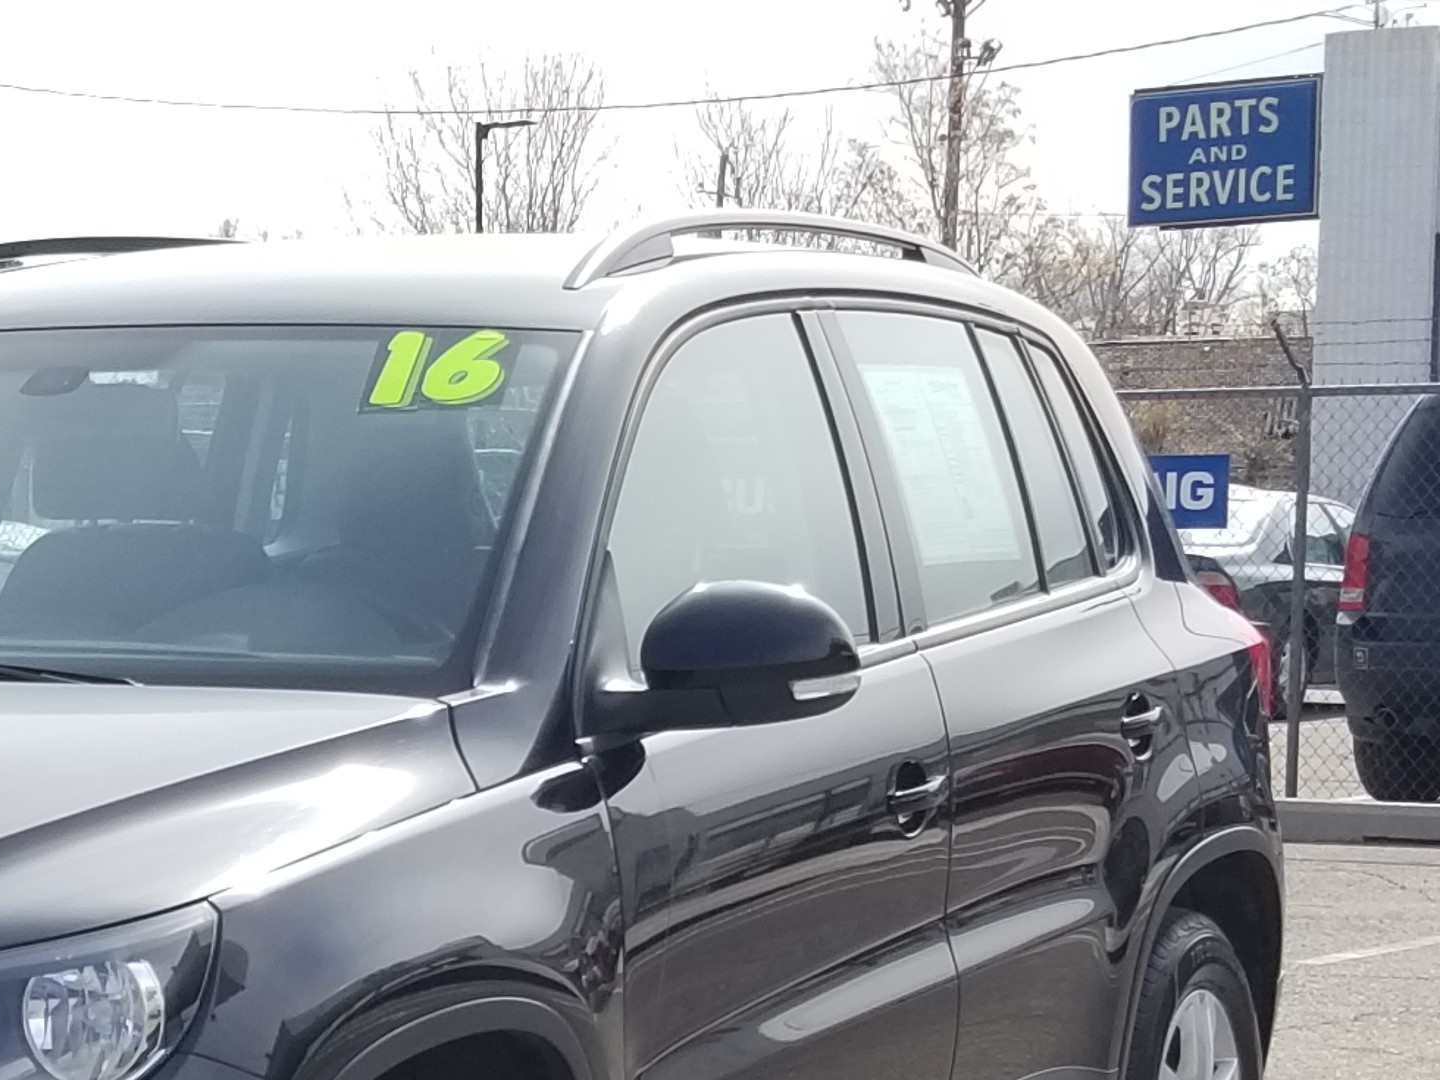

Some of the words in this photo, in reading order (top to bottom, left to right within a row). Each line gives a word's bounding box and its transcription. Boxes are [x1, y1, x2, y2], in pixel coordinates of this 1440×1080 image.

[1158, 97, 1280, 143] PARTS
[1188, 144, 1248, 165] AND
[1141, 164, 1295, 211] SERVICE
[369, 329, 509, 407] 16
